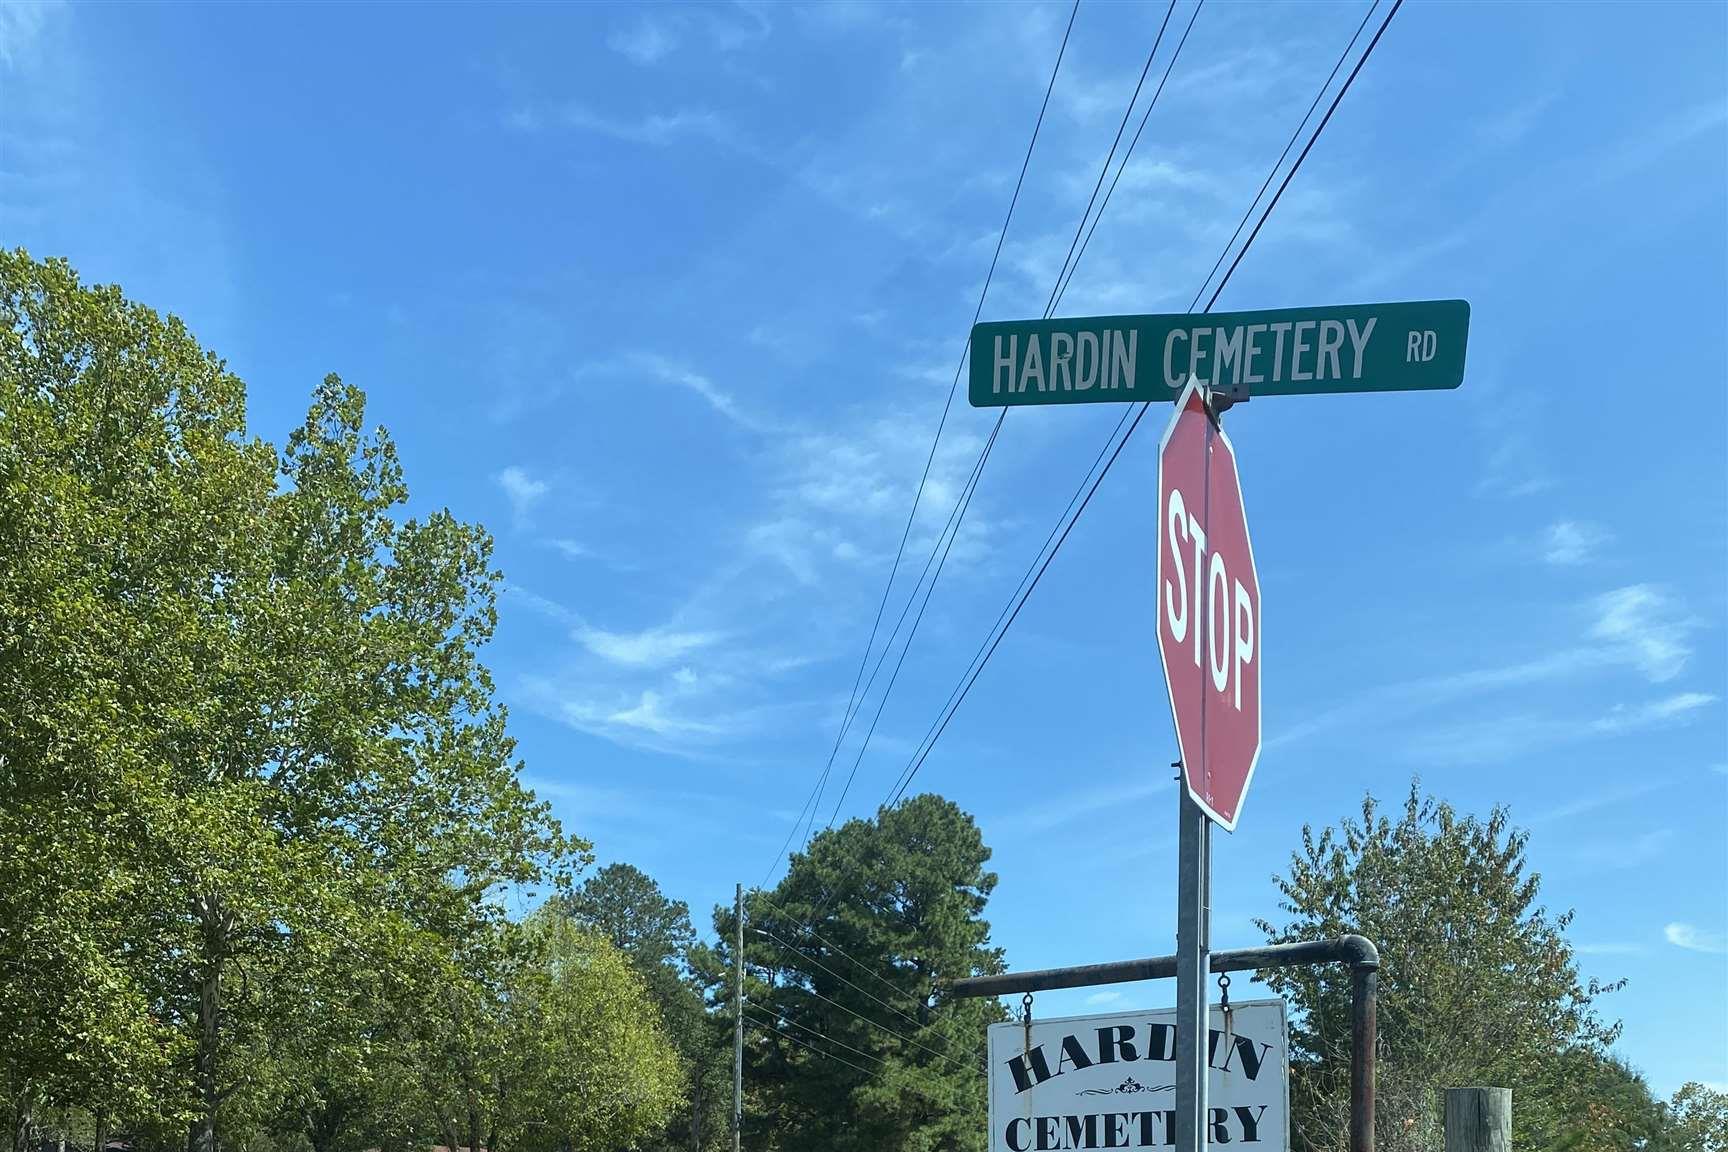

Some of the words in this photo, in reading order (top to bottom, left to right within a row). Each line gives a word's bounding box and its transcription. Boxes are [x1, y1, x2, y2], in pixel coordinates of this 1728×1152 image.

[992, 329, 1137, 394] HARDIN
[1163, 317, 1378, 389] CEMETERY
[1406, 330, 1437, 362] RD
[1166, 488, 1254, 712] STOP
